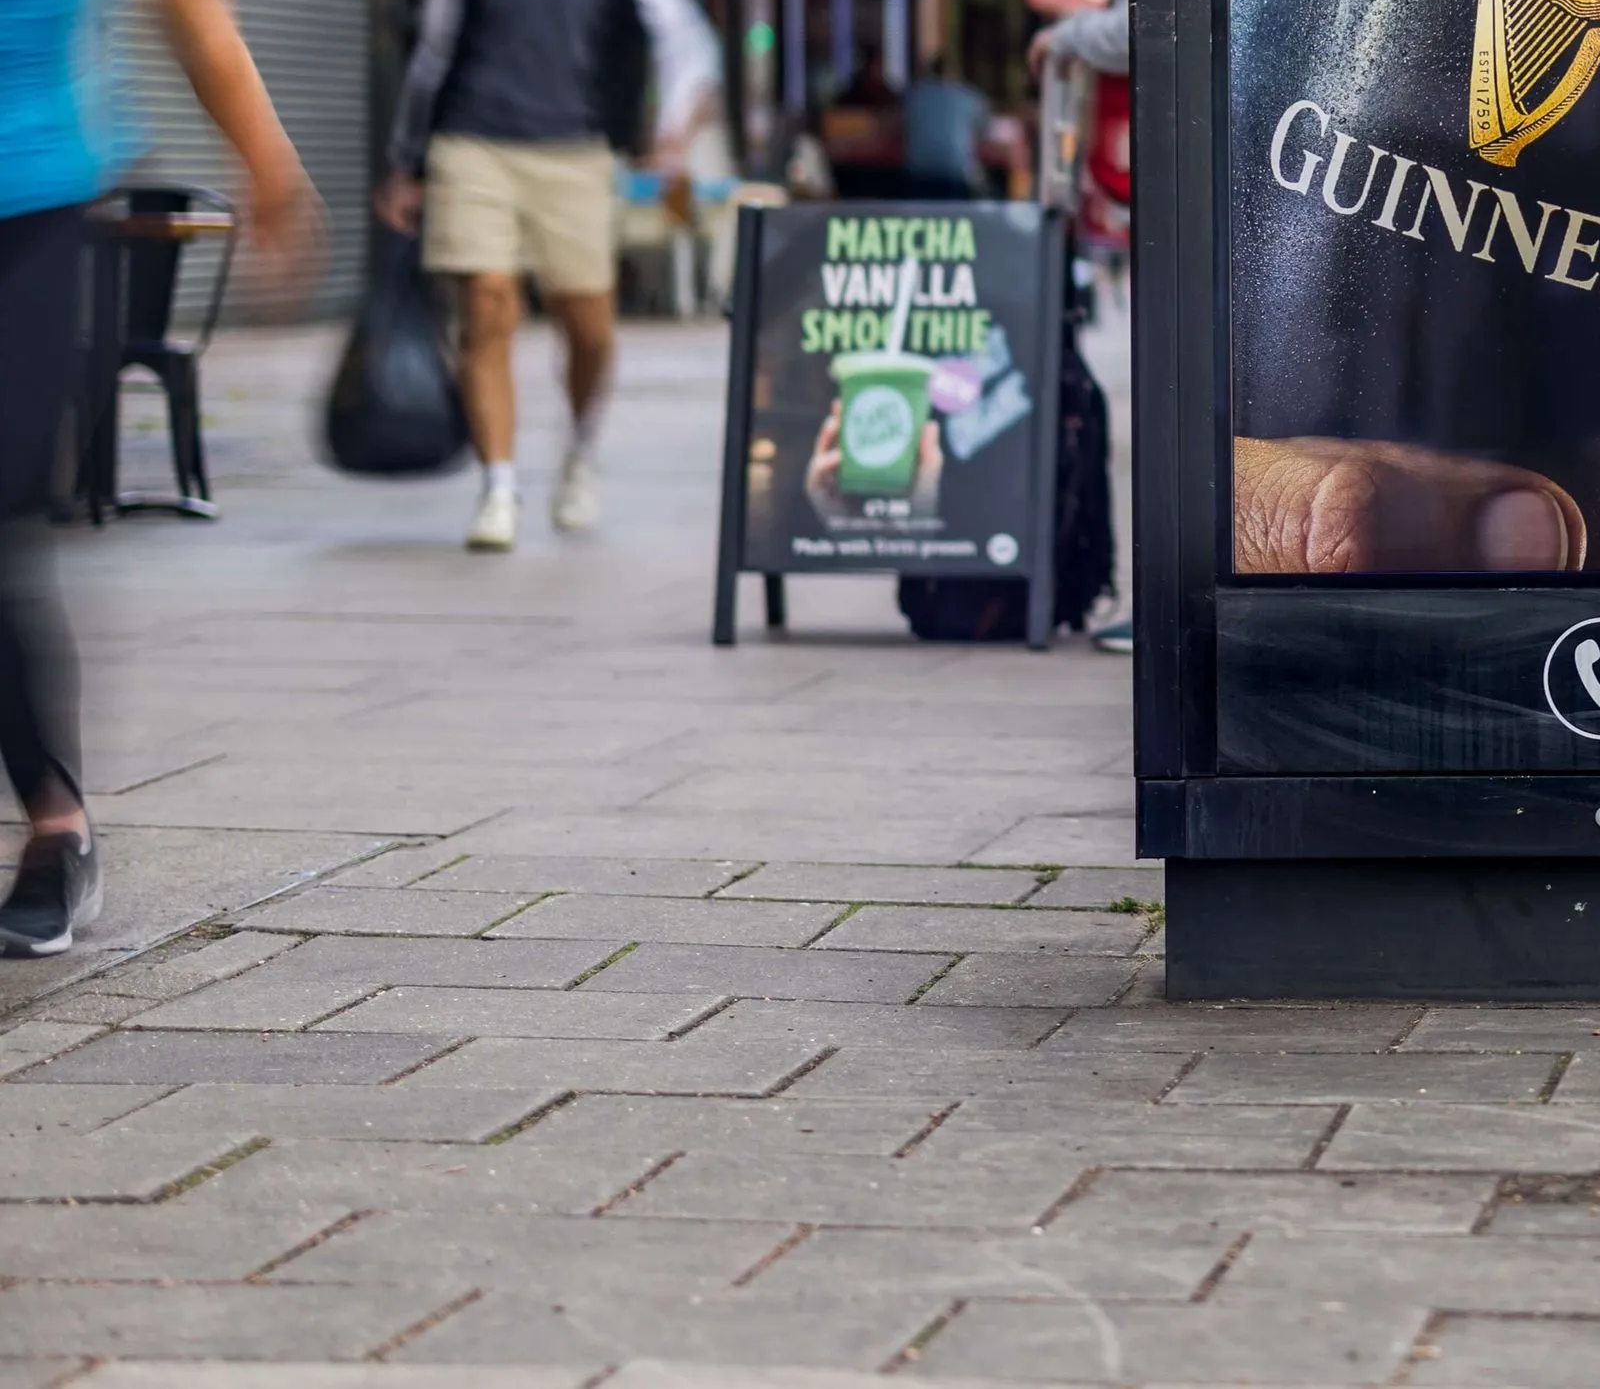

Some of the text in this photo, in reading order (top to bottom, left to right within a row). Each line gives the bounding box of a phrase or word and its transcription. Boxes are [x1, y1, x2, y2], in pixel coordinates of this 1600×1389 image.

[1476, 89, 1491, 130] 1759
[827, 218, 976, 260] MATCHA
[822, 263, 977, 307] VANLLA
